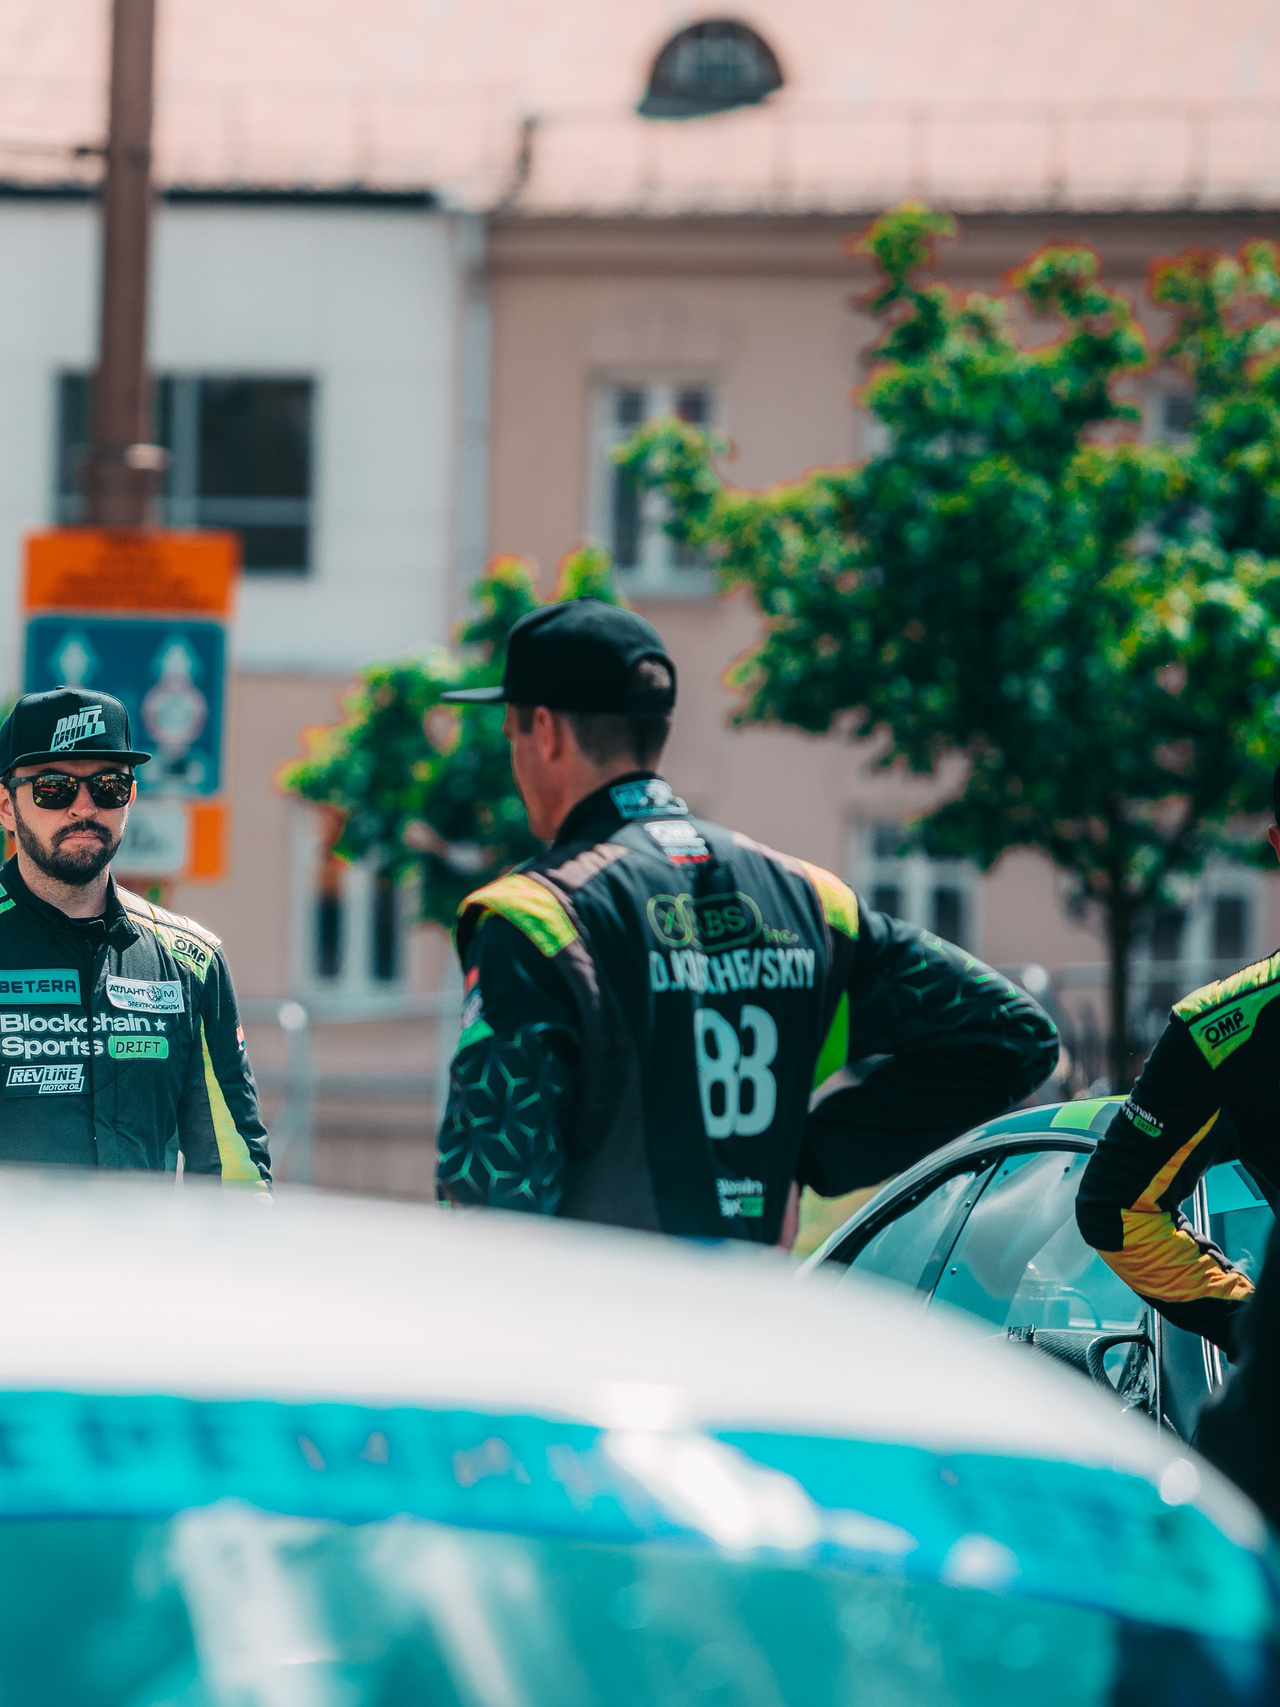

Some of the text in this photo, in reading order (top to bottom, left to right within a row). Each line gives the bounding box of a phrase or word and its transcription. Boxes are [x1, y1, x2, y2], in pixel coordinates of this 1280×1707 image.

[175, 939, 206, 962] OMP
[109, 984, 146, 997] АТЛАНТ
[0, 1012, 152, 1033] Blockchain
[1205, 1010, 1245, 1044] OMP
[1, 1036, 161, 1060] Sports DRIFT
